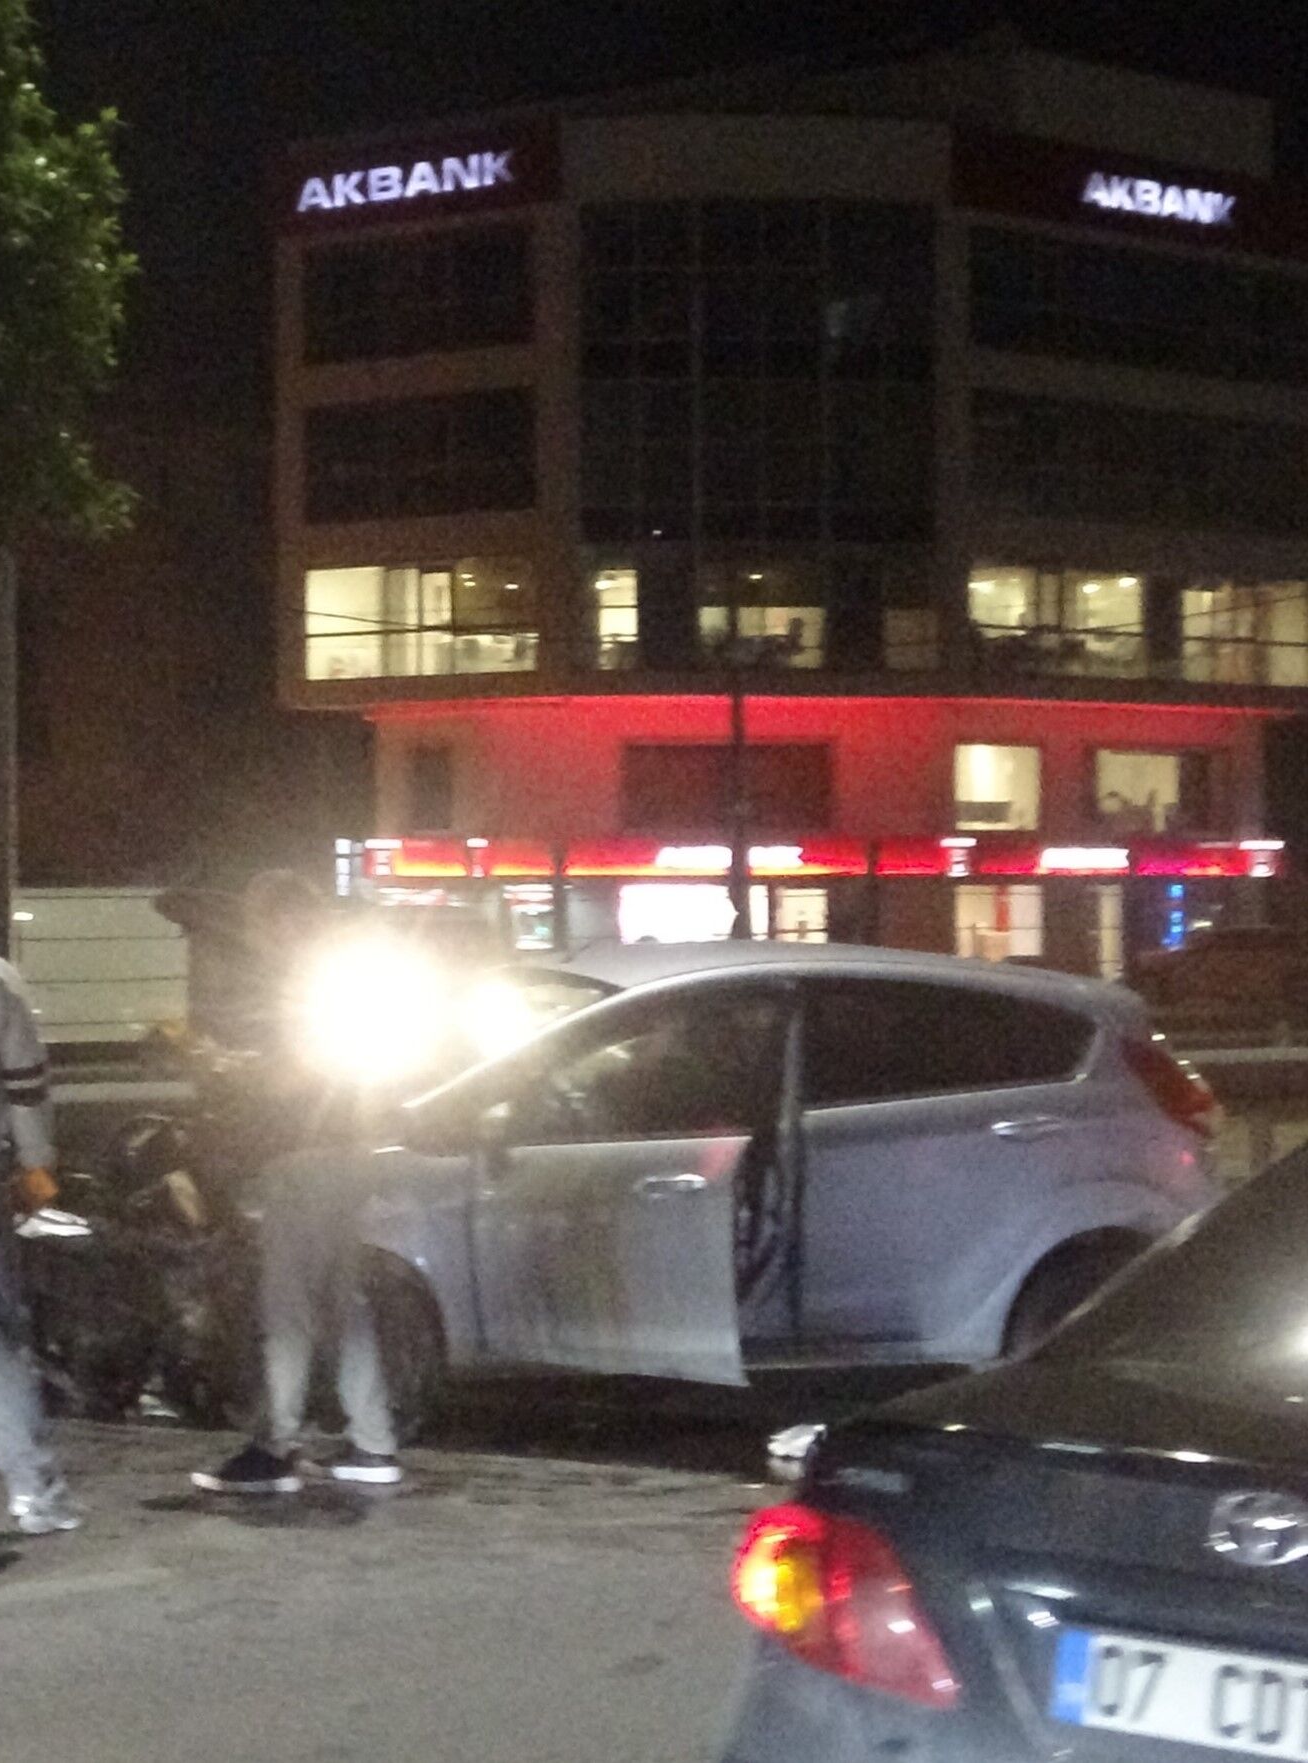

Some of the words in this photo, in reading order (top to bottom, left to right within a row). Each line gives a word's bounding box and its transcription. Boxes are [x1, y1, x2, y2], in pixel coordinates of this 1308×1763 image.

[296, 152, 514, 212] AKBANK
[1083, 171, 1237, 225] AKBANK
[1097, 1645, 1166, 1722] 07
